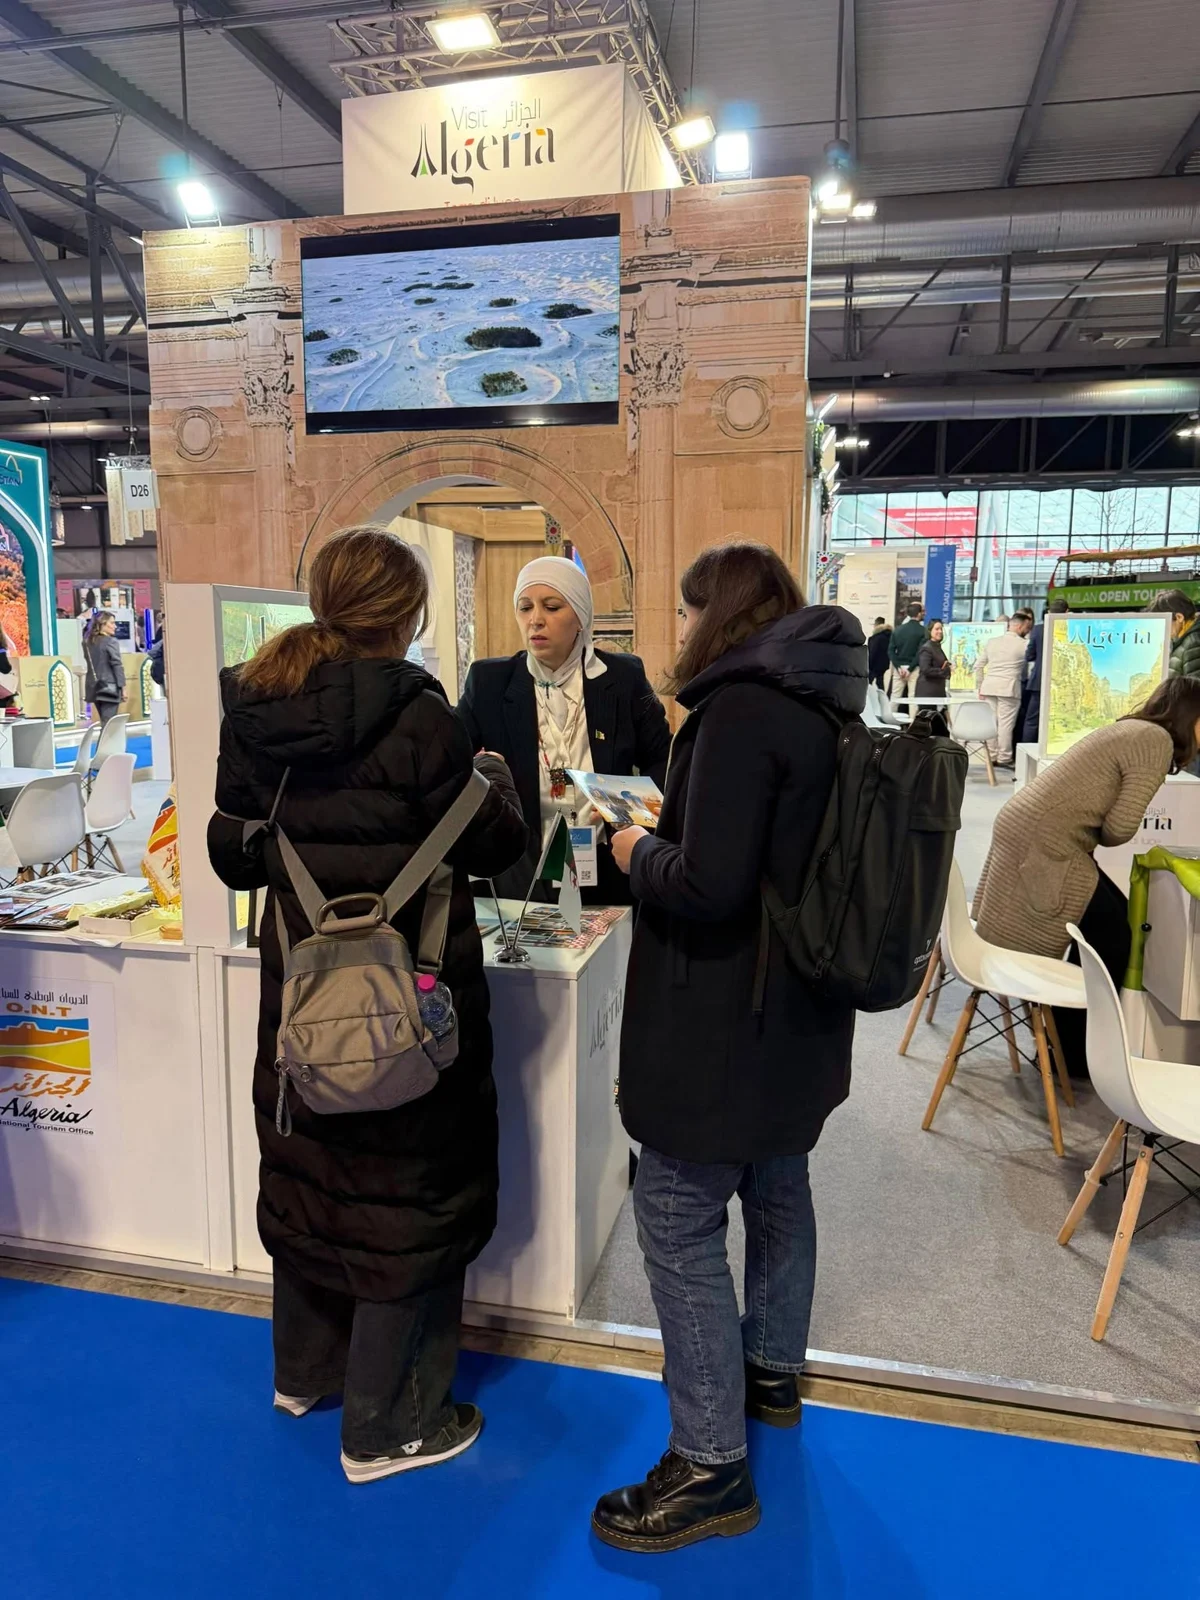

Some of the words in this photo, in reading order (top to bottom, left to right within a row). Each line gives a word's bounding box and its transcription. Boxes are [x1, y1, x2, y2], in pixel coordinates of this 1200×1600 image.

[451, 105, 488, 131] Visit
[502, 98, 541, 129] الجزائر
[410, 120, 556, 194] Algeria
[130, 484, 150, 498] D26
[1067, 591, 1098, 604] MILAN
[1098, 589, 1130, 602] OPEN
[1069, 625, 1151, 650] Algeria
[6, 1002, 72, 1017] O.N.T
[0, 1072, 91, 1099] الجزائر
[0, 1097, 93, 1129] Algeria
[0, 1120, 30, 1128] ational
[33, 1122, 66, 1132] Tourism
[68, 1127, 94, 1135] Office
